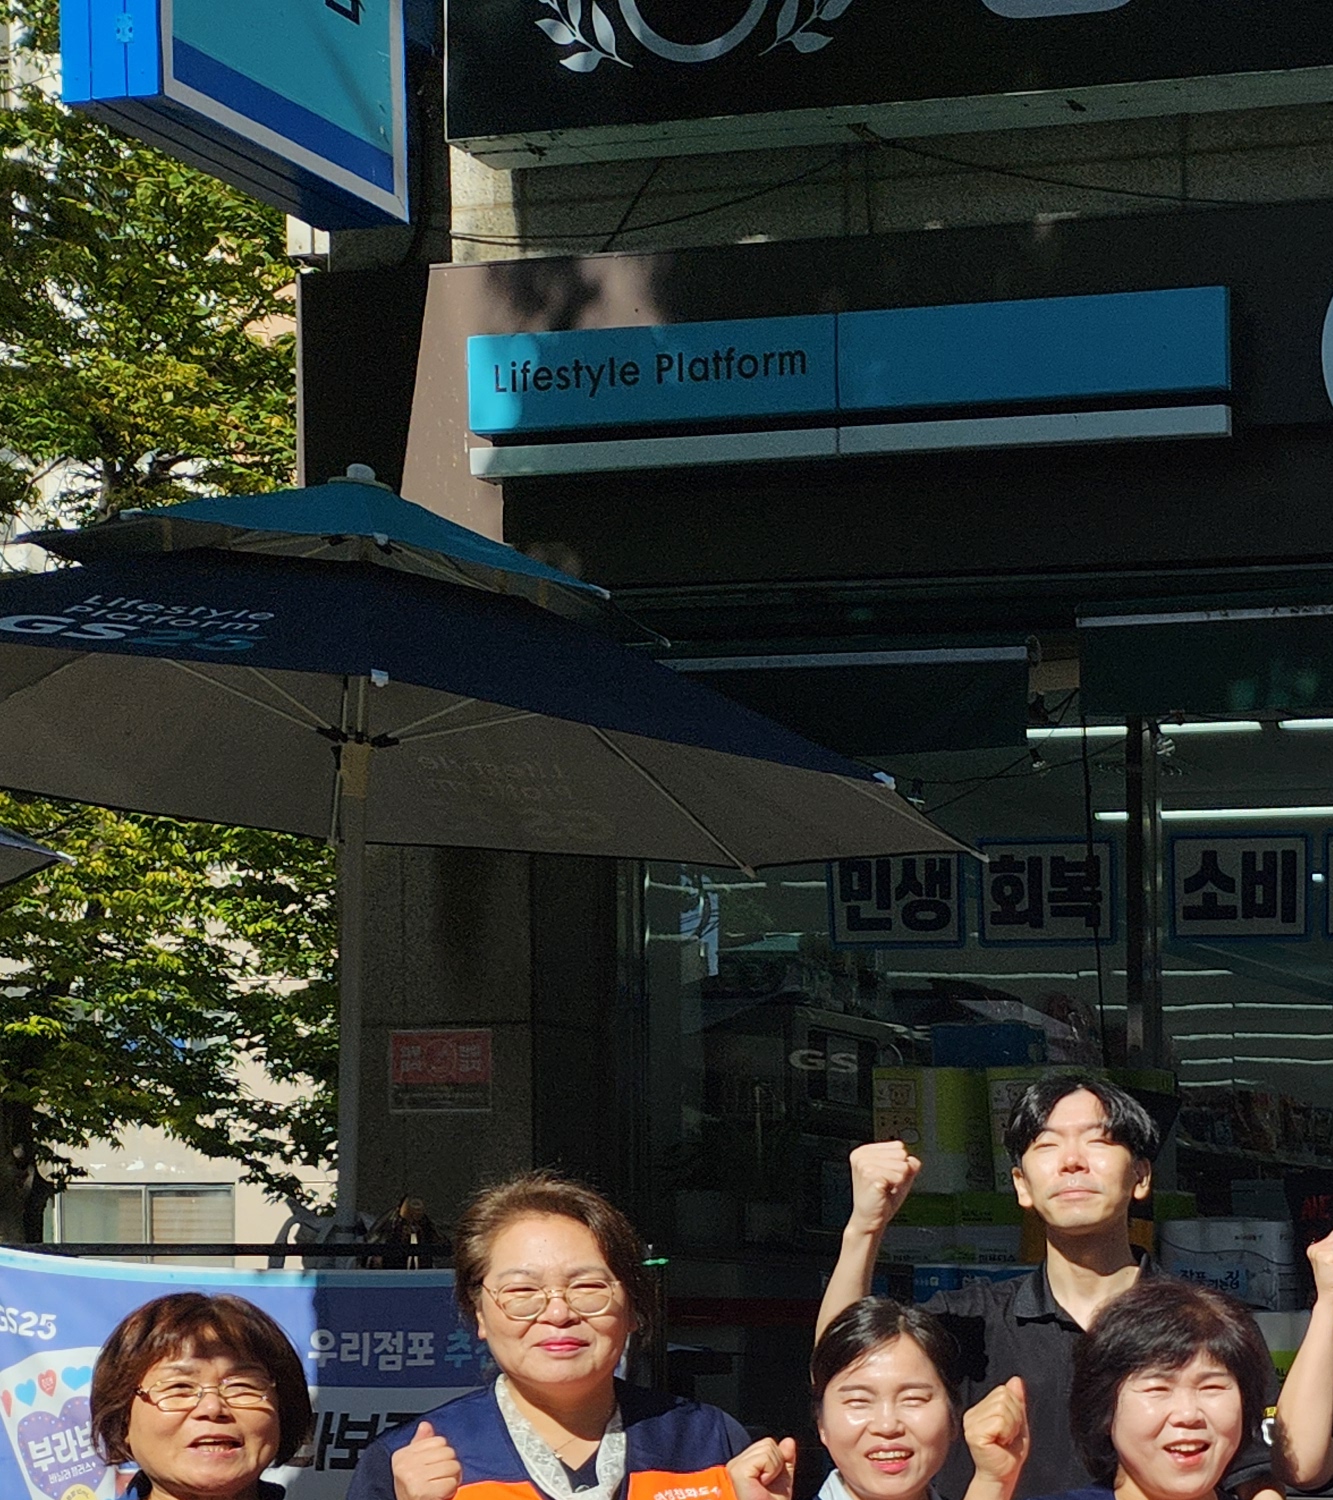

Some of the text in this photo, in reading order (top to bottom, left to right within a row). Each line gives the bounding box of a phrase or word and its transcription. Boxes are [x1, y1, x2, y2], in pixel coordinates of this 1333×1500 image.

[493, 347, 807, 398] Lifestyle Platform
[0, 614, 267, 652] GS25
[838, 855, 953, 933] 민생
[989, 854, 1101, 930] 회복
[1180, 847, 1299, 925] 소비
[308, 1329, 435, 1372] 우리점포
